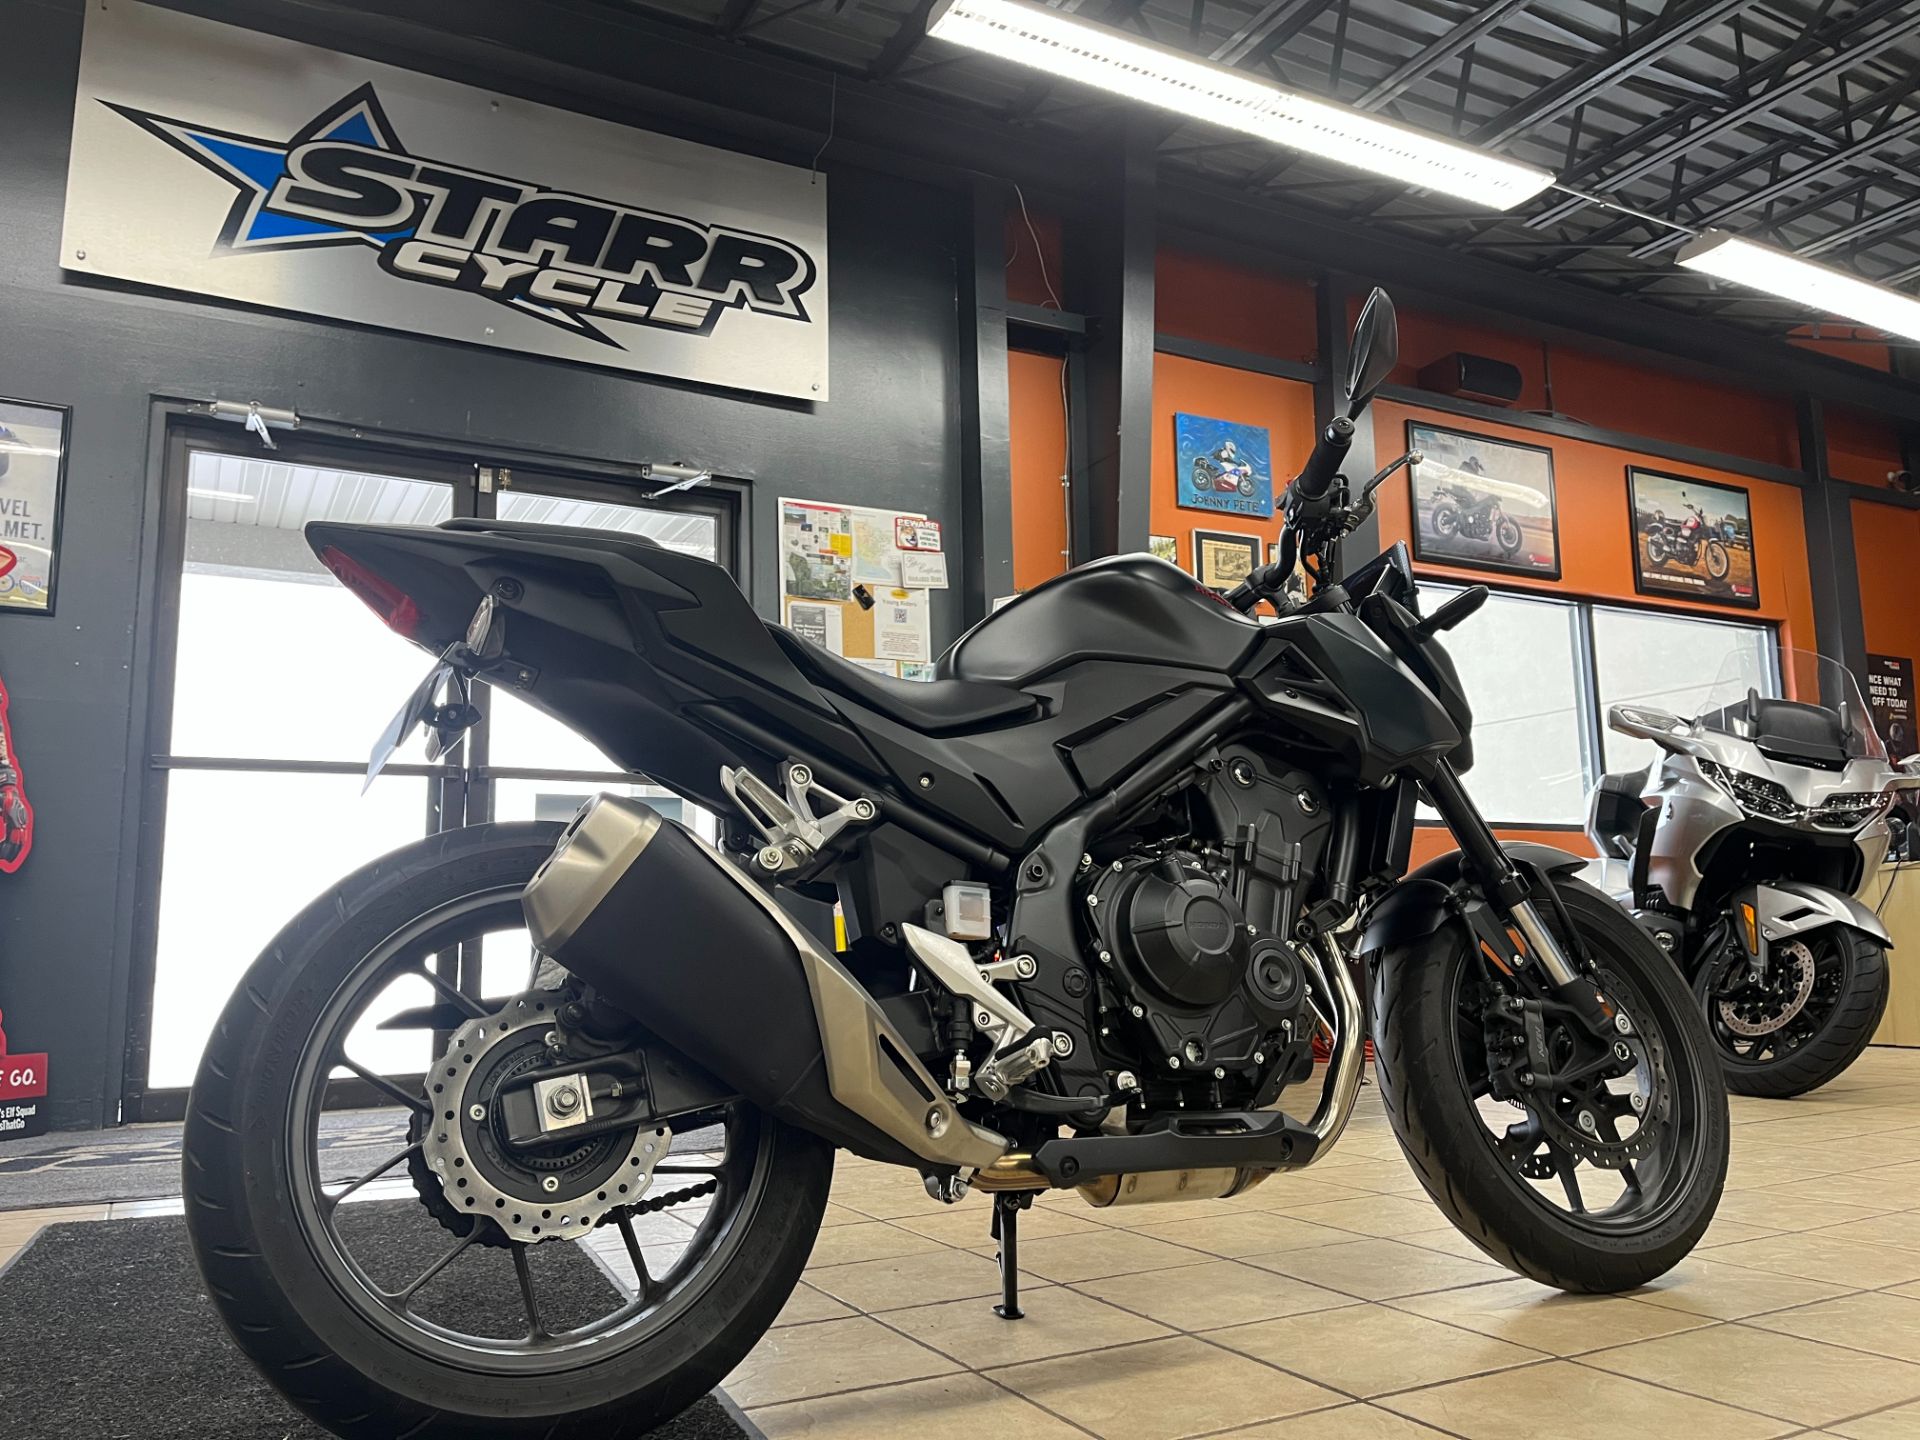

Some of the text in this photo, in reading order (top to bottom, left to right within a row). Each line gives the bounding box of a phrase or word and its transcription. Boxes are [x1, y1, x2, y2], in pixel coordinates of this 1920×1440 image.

[284, 141, 804, 308] STARR
[392, 239, 712, 328] CYCLE
[1191, 493, 1259, 513] JOHNNY PETE
[0, 520, 45, 541] MET.
[1883, 676, 1902, 687] WHAT
[1869, 686, 1897, 697] NEED TO
[1872, 696, 1908, 709] OFF TODAY
[10, 1068, 37, 1087] GO.
